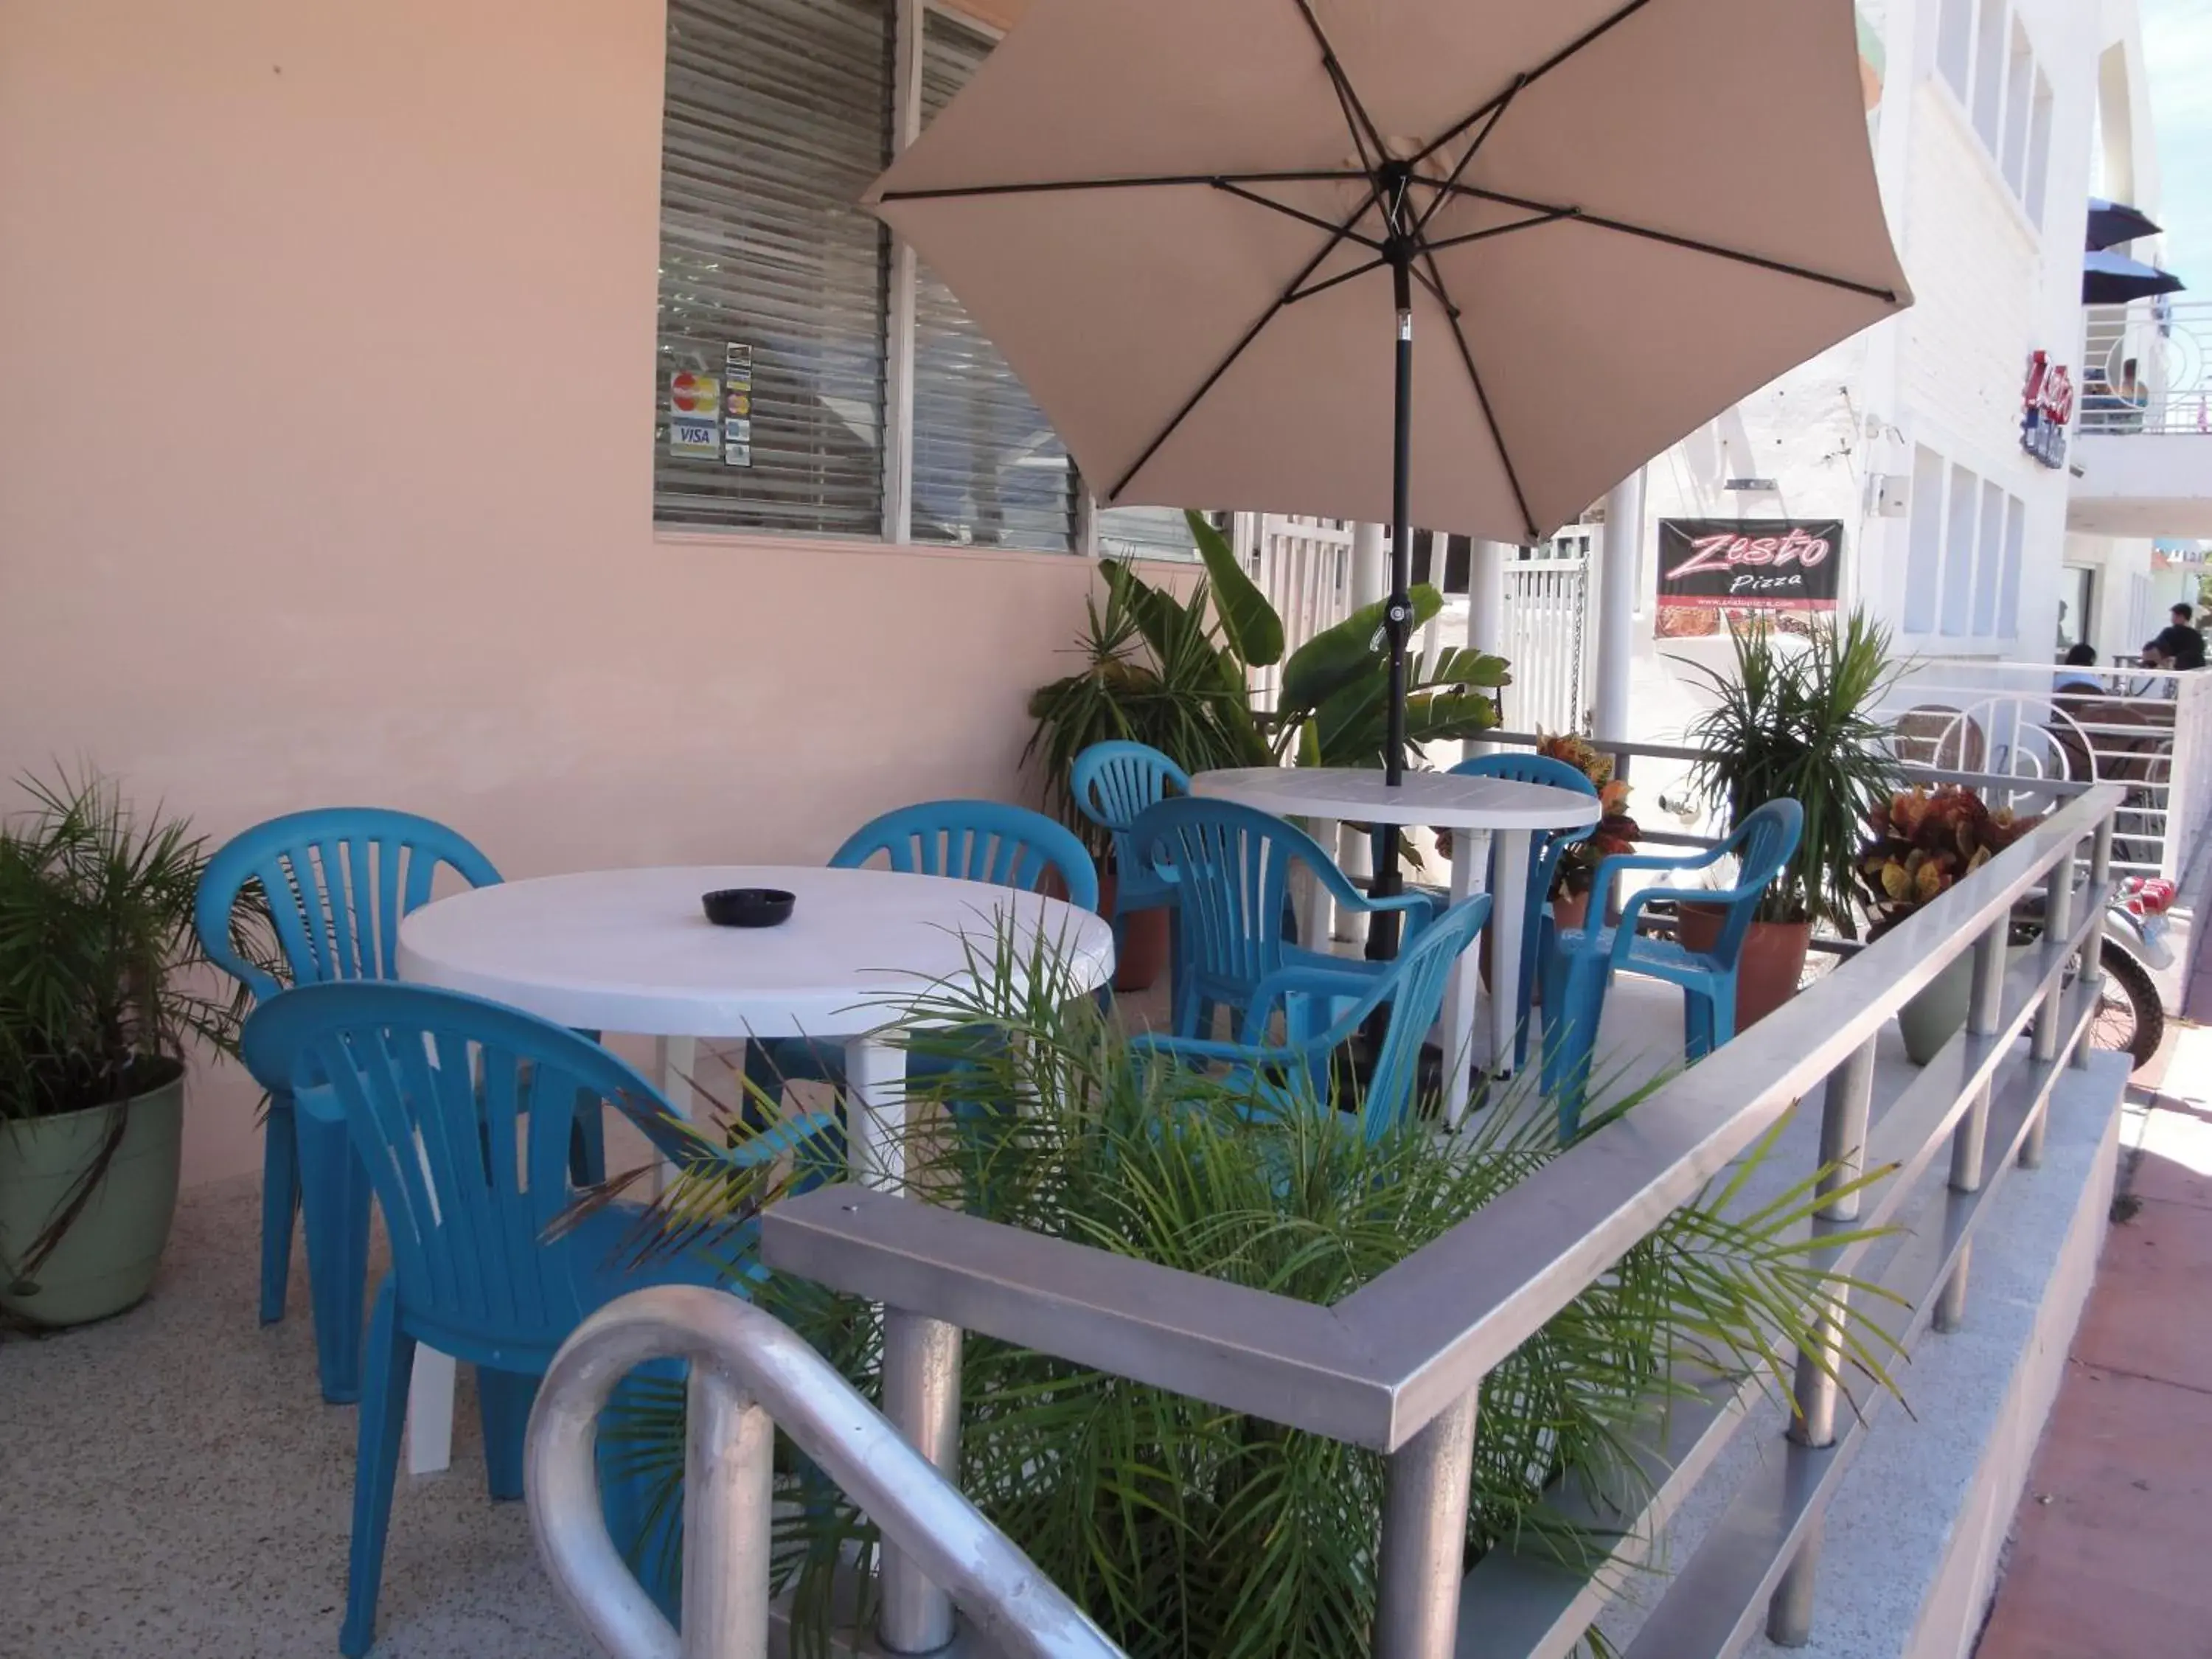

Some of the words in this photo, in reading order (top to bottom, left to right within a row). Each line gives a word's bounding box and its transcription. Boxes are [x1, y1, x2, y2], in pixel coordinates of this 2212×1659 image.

[681, 428, 710, 443] VISA
[1666, 529, 1829, 580] Zesto
[1729, 574, 1802, 593] Pizza
